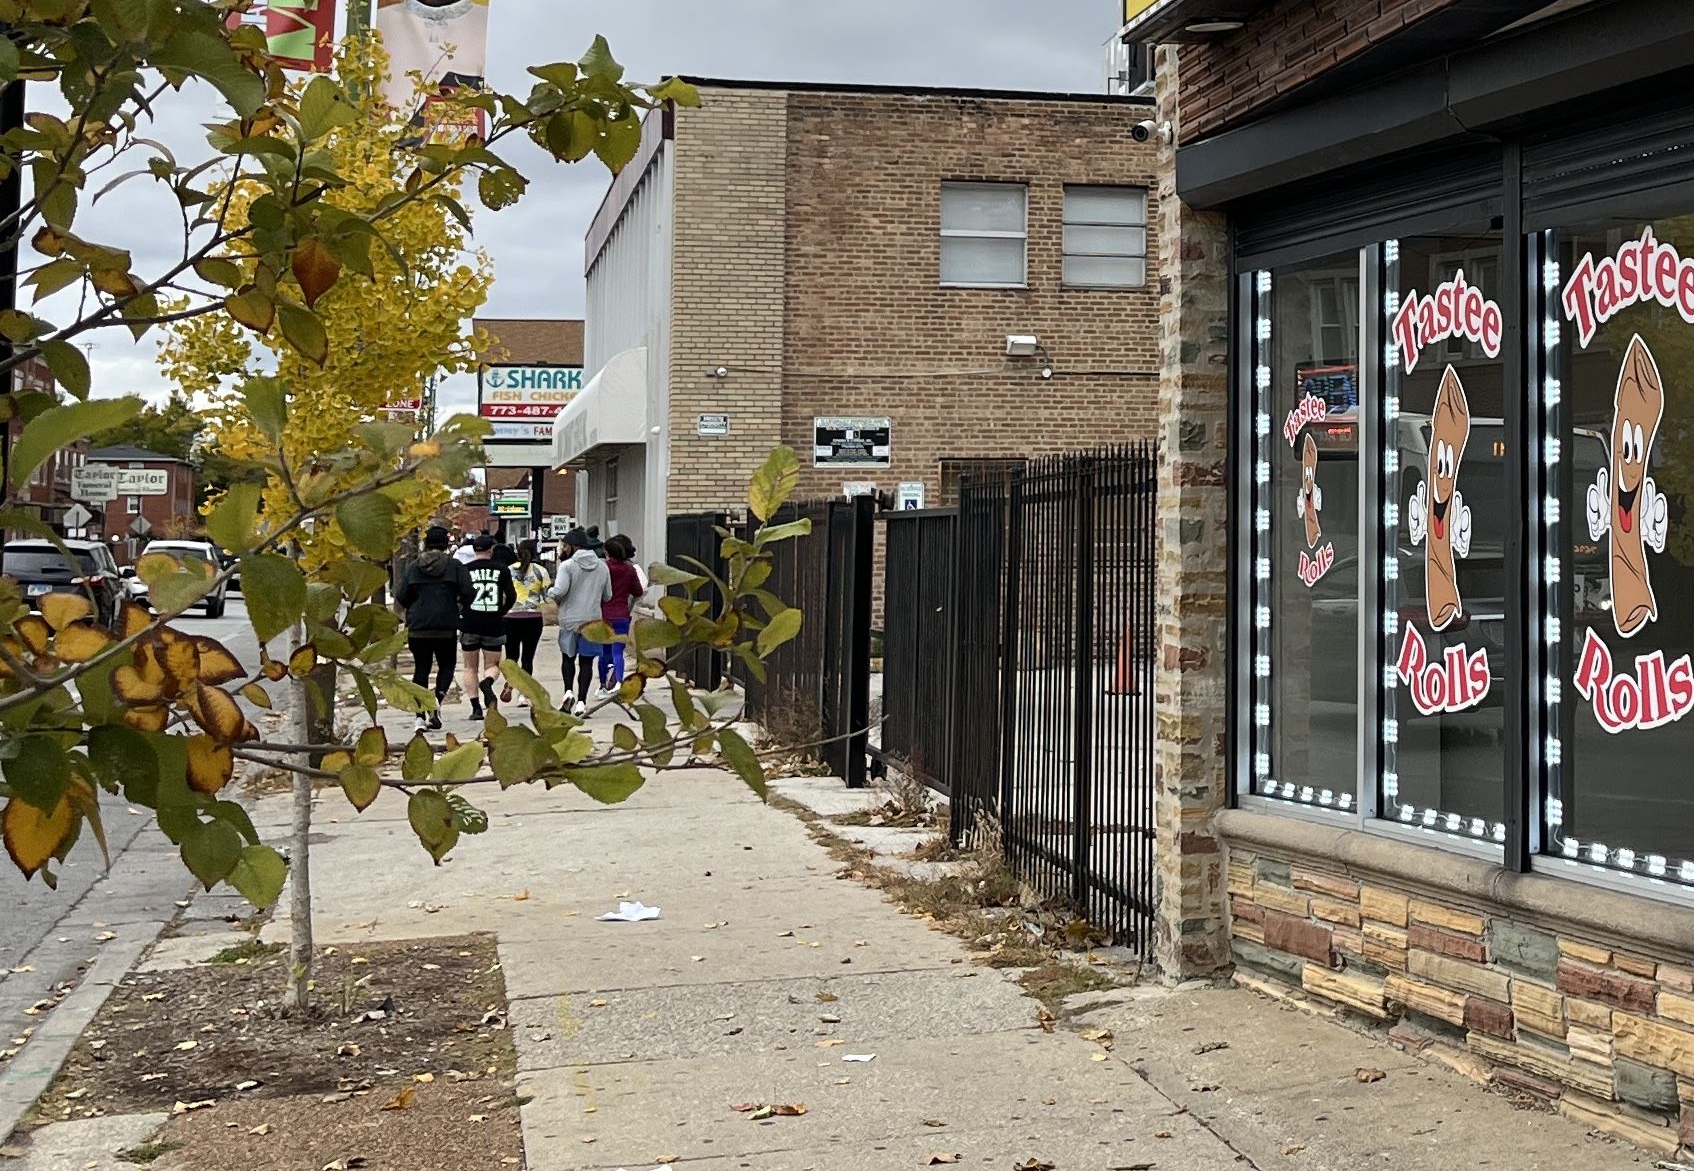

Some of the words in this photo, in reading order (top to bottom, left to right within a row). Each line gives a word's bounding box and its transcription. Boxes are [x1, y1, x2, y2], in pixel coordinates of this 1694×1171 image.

[1394, 273, 1501, 365] Tastee
[492, 391, 522, 401] FISH
[1284, 393, 1325, 444] Tastee
[470, 569, 501, 582] MILE
[1298, 543, 1334, 585] Rolls
[471, 582, 498, 605] 23
[1398, 625, 1490, 712] Rolls
[1575, 630, 1694, 729] Rolls
